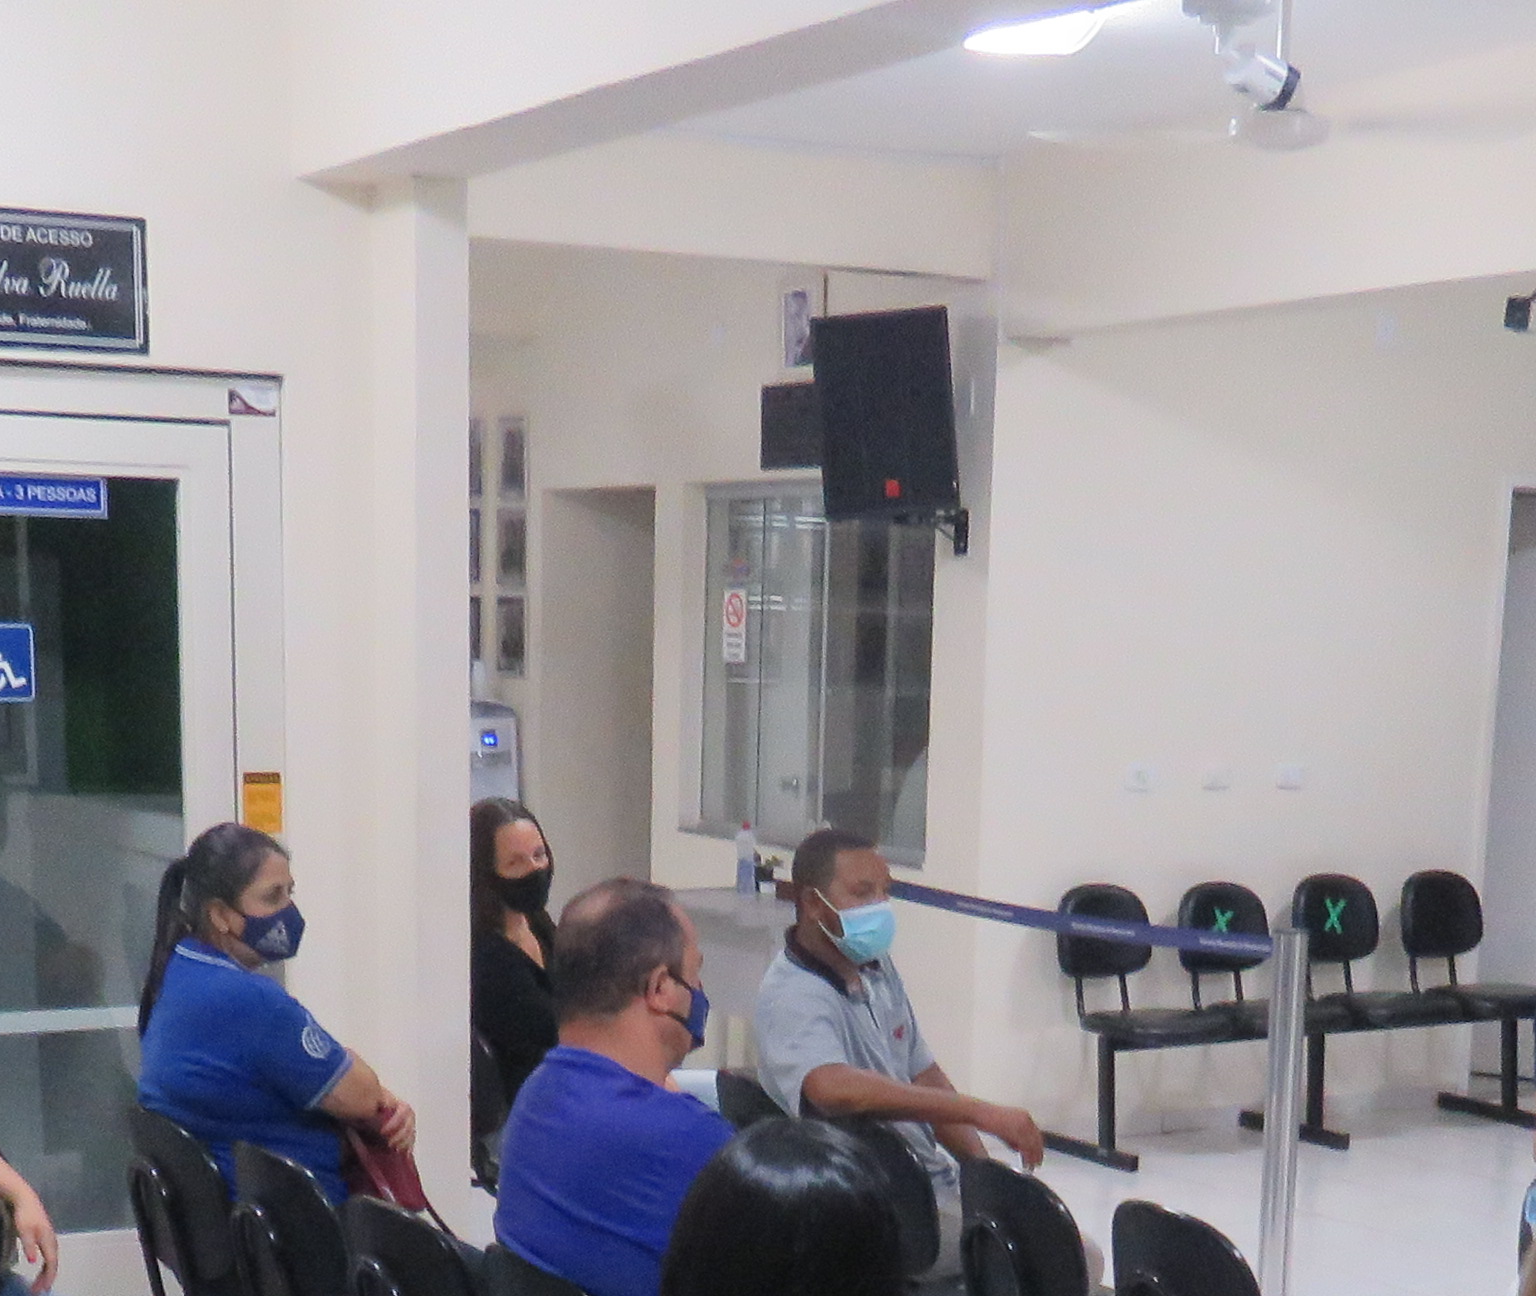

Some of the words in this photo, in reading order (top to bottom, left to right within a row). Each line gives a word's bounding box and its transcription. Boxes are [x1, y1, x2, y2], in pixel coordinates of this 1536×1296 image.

[0, 226, 24, 243] DE
[25, 227, 94, 248] ACESSO
[38, 255, 119, 302] Ruella
[14, 484, 25, 501] 3
[26, 485, 97, 504] PESSOAS
